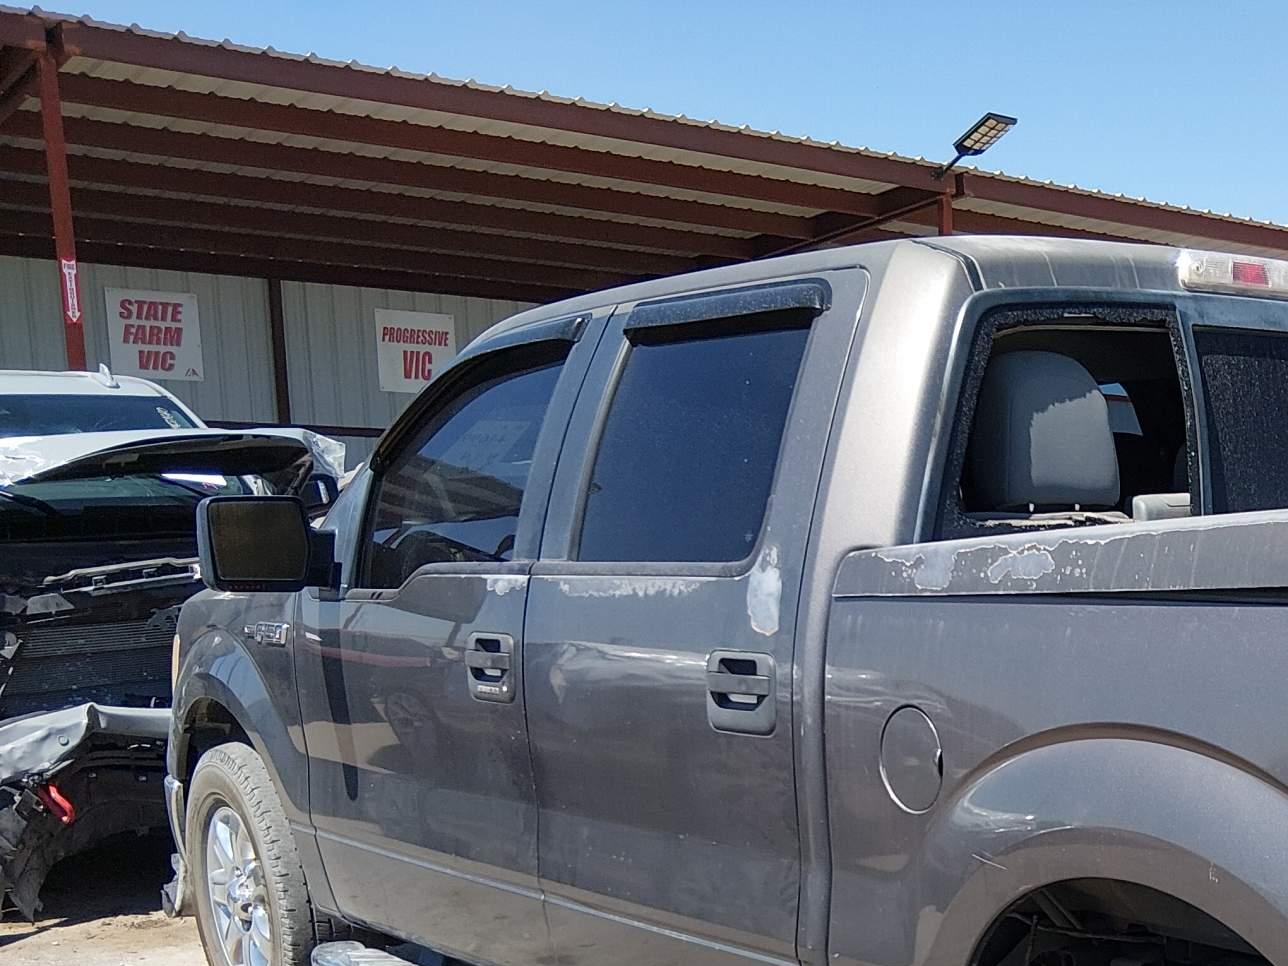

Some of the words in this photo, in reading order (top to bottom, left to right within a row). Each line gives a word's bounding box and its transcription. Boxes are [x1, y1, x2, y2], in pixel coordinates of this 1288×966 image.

[119, 299, 183, 323] STATE
[123, 324, 183, 347] FARM
[382, 326, 449, 347] PROGRESSIVE
[138, 350, 176, 372] VIC
[403, 350, 433, 380] VIC
